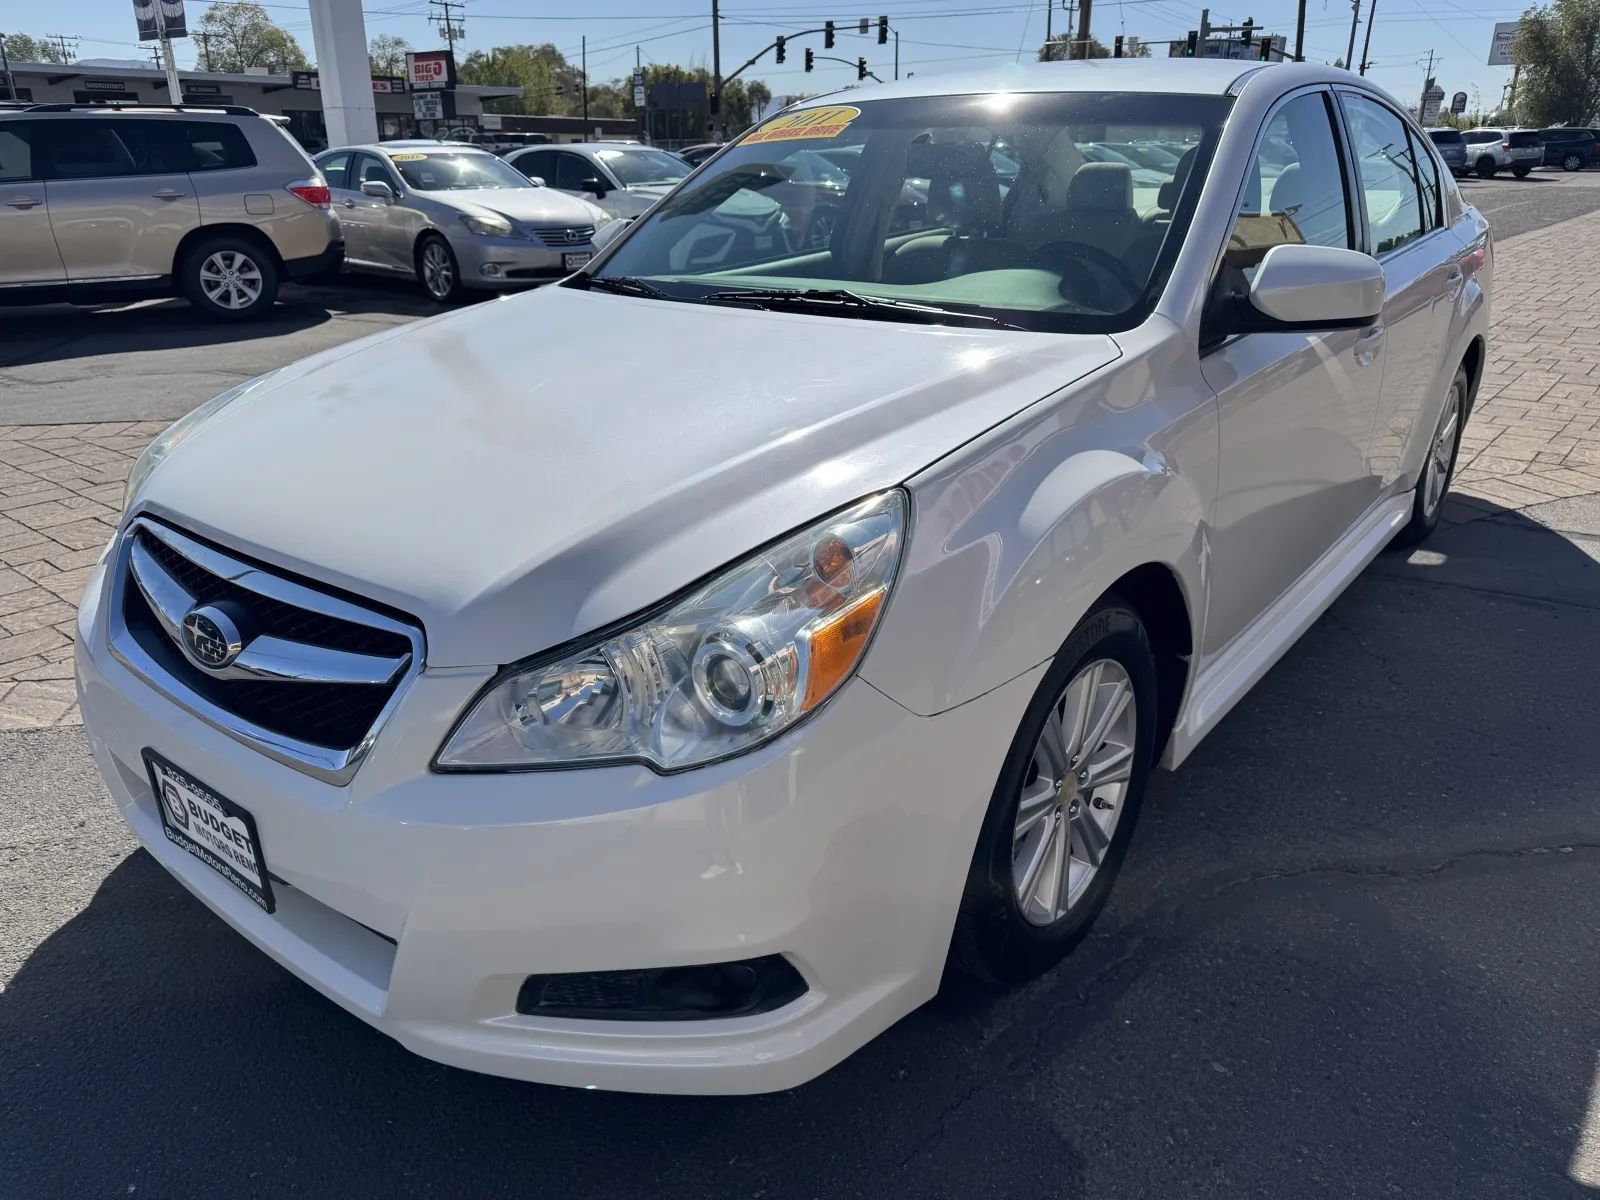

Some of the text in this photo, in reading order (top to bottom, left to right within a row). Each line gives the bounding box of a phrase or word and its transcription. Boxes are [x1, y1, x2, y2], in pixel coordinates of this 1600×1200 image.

[414, 63, 432, 75] BIG
[415, 74, 434, 82] TIRES
[770, 109, 850, 130] 2011
[800, 123, 848, 138] DRIVE
[165, 766, 223, 812] 825-9555
[187, 798, 252, 855] BUDGET
[193, 820, 234, 859] MOTORS
[164, 826, 268, 911] BudgetMotorsReno.com
